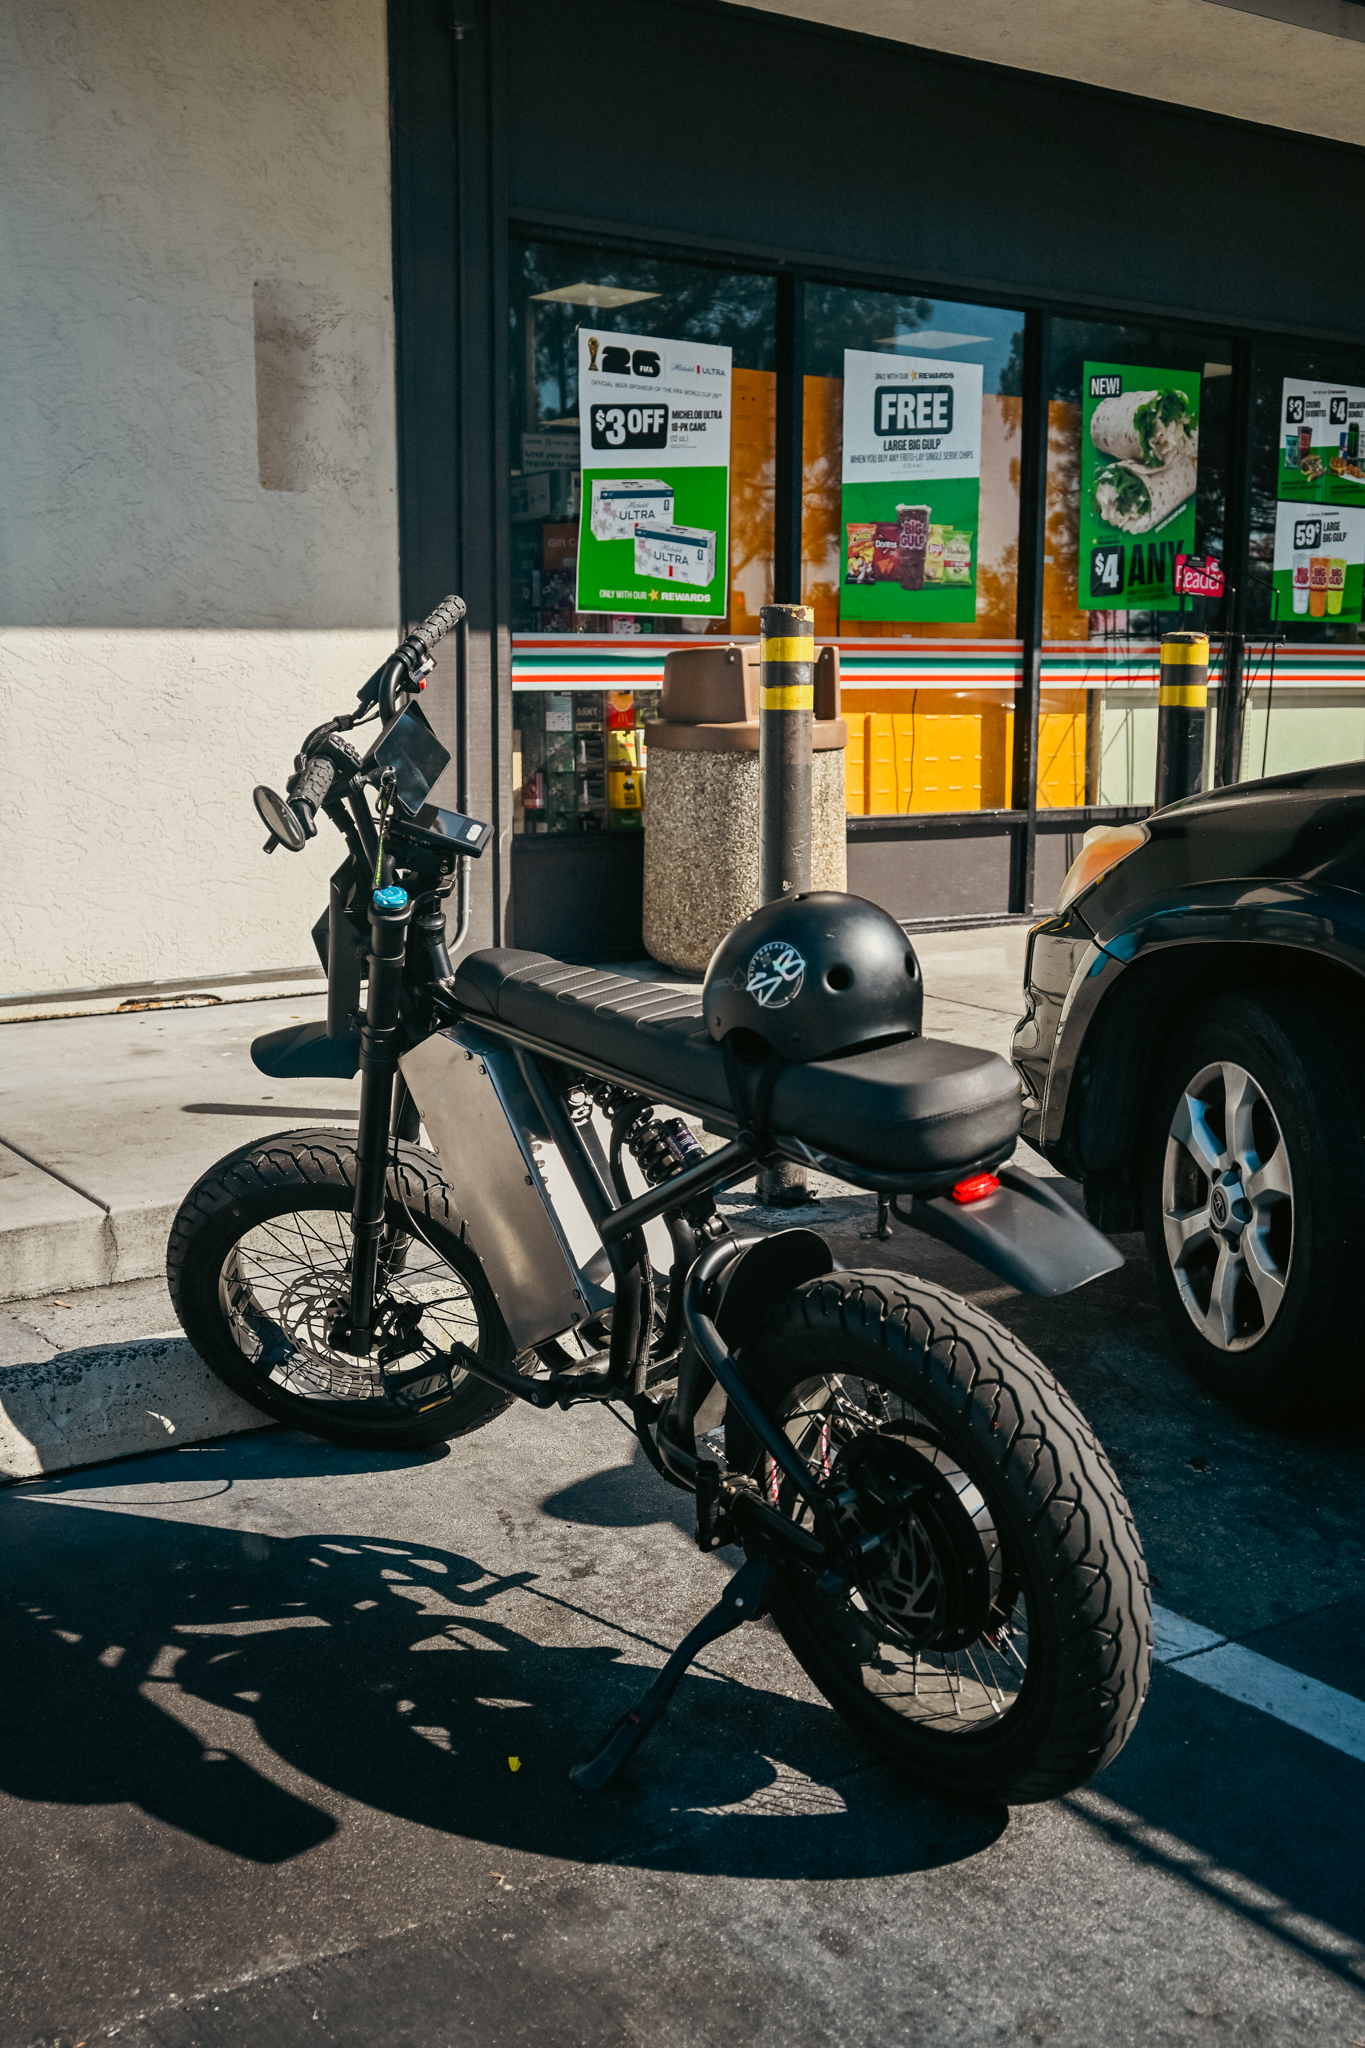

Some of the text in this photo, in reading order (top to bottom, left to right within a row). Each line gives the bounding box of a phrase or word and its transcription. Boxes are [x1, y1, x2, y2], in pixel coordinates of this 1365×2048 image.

[602, 345, 661, 378] 26
[639, 365, 654, 373] FIFA
[702, 367, 726, 376] ULTRA
[591, 379, 613, 388] OFFICIAL
[629, 383, 653, 391] SPONSOR
[684, 389, 701, 397] WORLD
[1091, 378, 1120, 395] NEW!
[671, 410, 723, 419] MICHELOB ULTRA
[880, 392, 949, 430] FREE
[1288, 399, 1303, 420] $3
[1332, 399, 1346, 421] $4
[595, 408, 665, 445] $3 OFF
[671, 422, 707, 431] 18-PK CANS
[883, 440, 906, 451] LARGE
[908, 439, 920, 450] BIG
[850, 454, 866, 463] WHEN
[867, 454, 877, 463] YOU
[878, 453, 889, 462] BUY
[889, 453, 899, 462] ANY
[925, 451, 942, 460] SINGLE
[943, 450, 959, 460] SERVE
[959, 450, 974, 459] CHIPS
[619, 510, 655, 520] ULTRA
[903, 521, 922, 535] BIG
[1323, 521, 1341, 532] LARGE
[900, 534, 926, 547] GULP
[1296, 522, 1320, 546] 59¢
[1323, 533, 1333, 543] BIG
[653, 551, 689, 565] ULTRA
[1128, 540, 1184, 587] ANY
[1094, 552, 1120, 588] $4
[599, 589, 711, 602] ONLY WITH OUR REWARDS
[576, 707, 598, 716] ARMY
